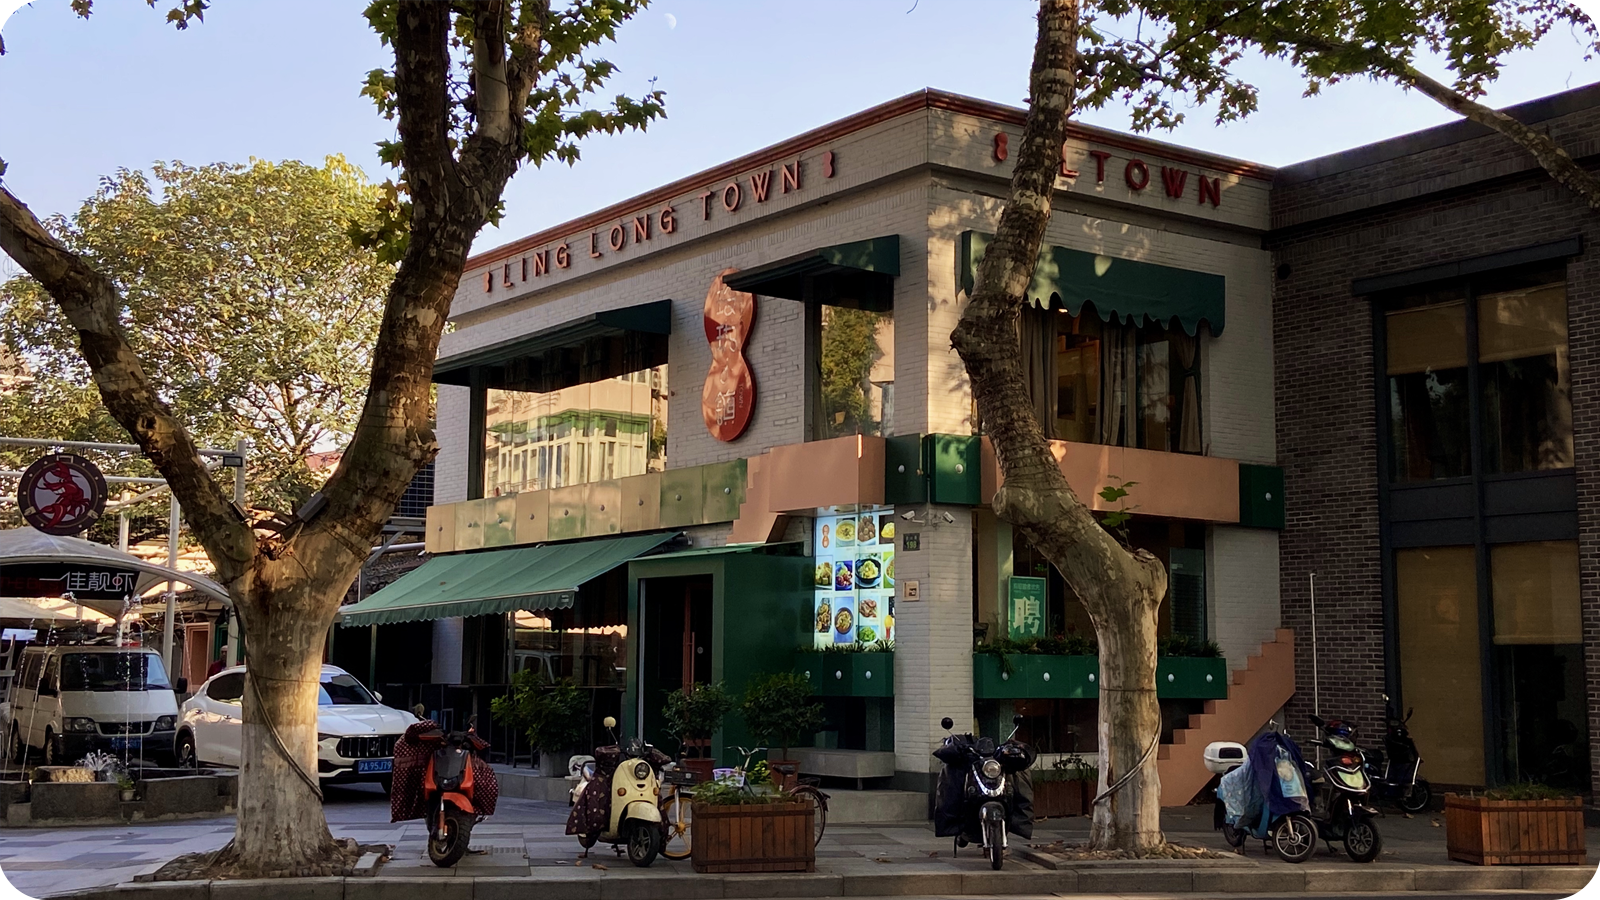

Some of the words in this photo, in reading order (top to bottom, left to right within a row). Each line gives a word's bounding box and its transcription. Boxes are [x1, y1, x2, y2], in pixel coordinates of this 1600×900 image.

[1090, 150, 1221, 208] TOWN
[502, 242, 571, 288] LING
[589, 205, 677, 259] LONG
[699, 160, 801, 221] TOWN
[1012, 595, 1042, 635] 聘
